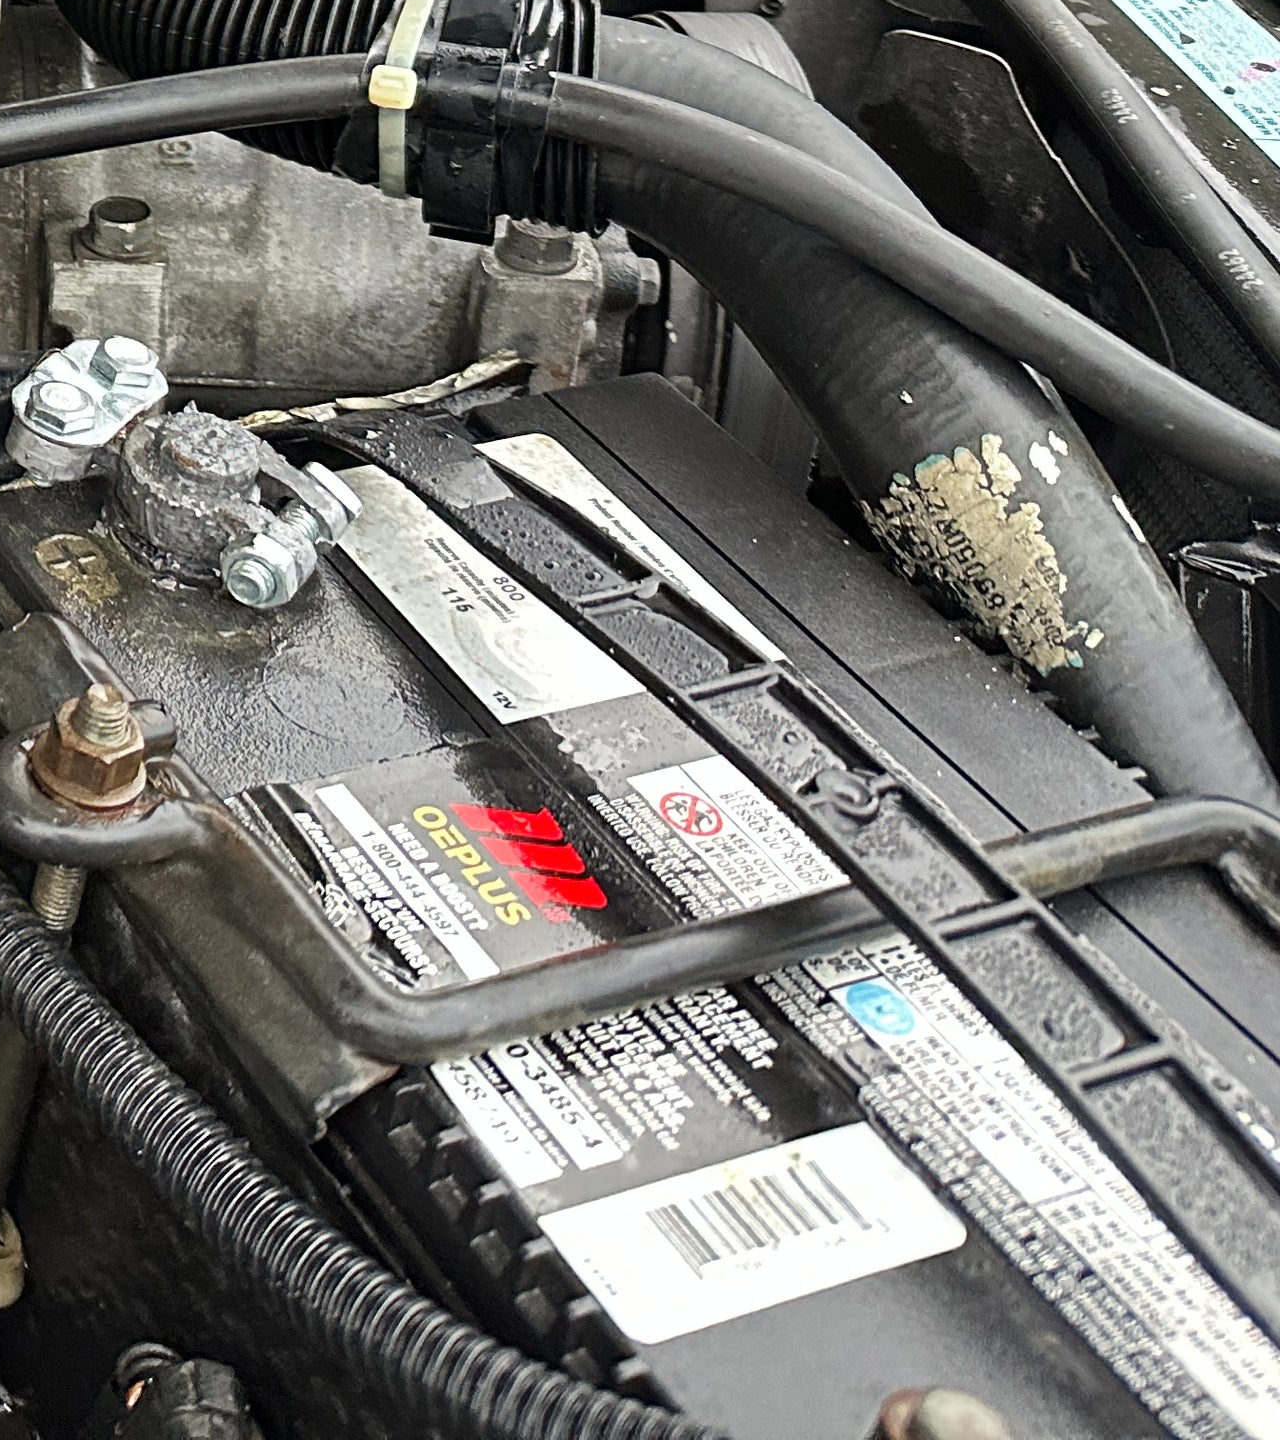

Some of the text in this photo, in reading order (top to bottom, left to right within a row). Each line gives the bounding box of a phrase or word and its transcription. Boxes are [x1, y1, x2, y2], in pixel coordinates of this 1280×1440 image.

[438, 586, 476, 613] 115
[491, 575, 527, 601] 800
[489, 690, 518, 710] 12V
[584, 794, 635, 837] INVERTED
[733, 789, 760, 806] LES
[406, 803, 537, 927] OEPLUS
[693, 840, 715, 853] LA
[726, 832, 758, 856] KEEP
[750, 858, 779, 879] OUT
[759, 835, 784, 850] OU
[336, 846, 396, 898] BESOIN
[384, 822, 491, 932] NEED A BOOST?
[669, 994, 737, 1052] RANTY.
[691, 993, 777, 1071] ACEMENT
[706, 985, 782, 1052] AR FREE
[580, 1023, 622, 1052] UIT
[605, 1051, 644, 1077] DE
[596, 1014, 697, 1111] PLACEMENT
[652, 1053, 690, 1078] DE
[501, 1042, 606, 1149] 0-3485-4
